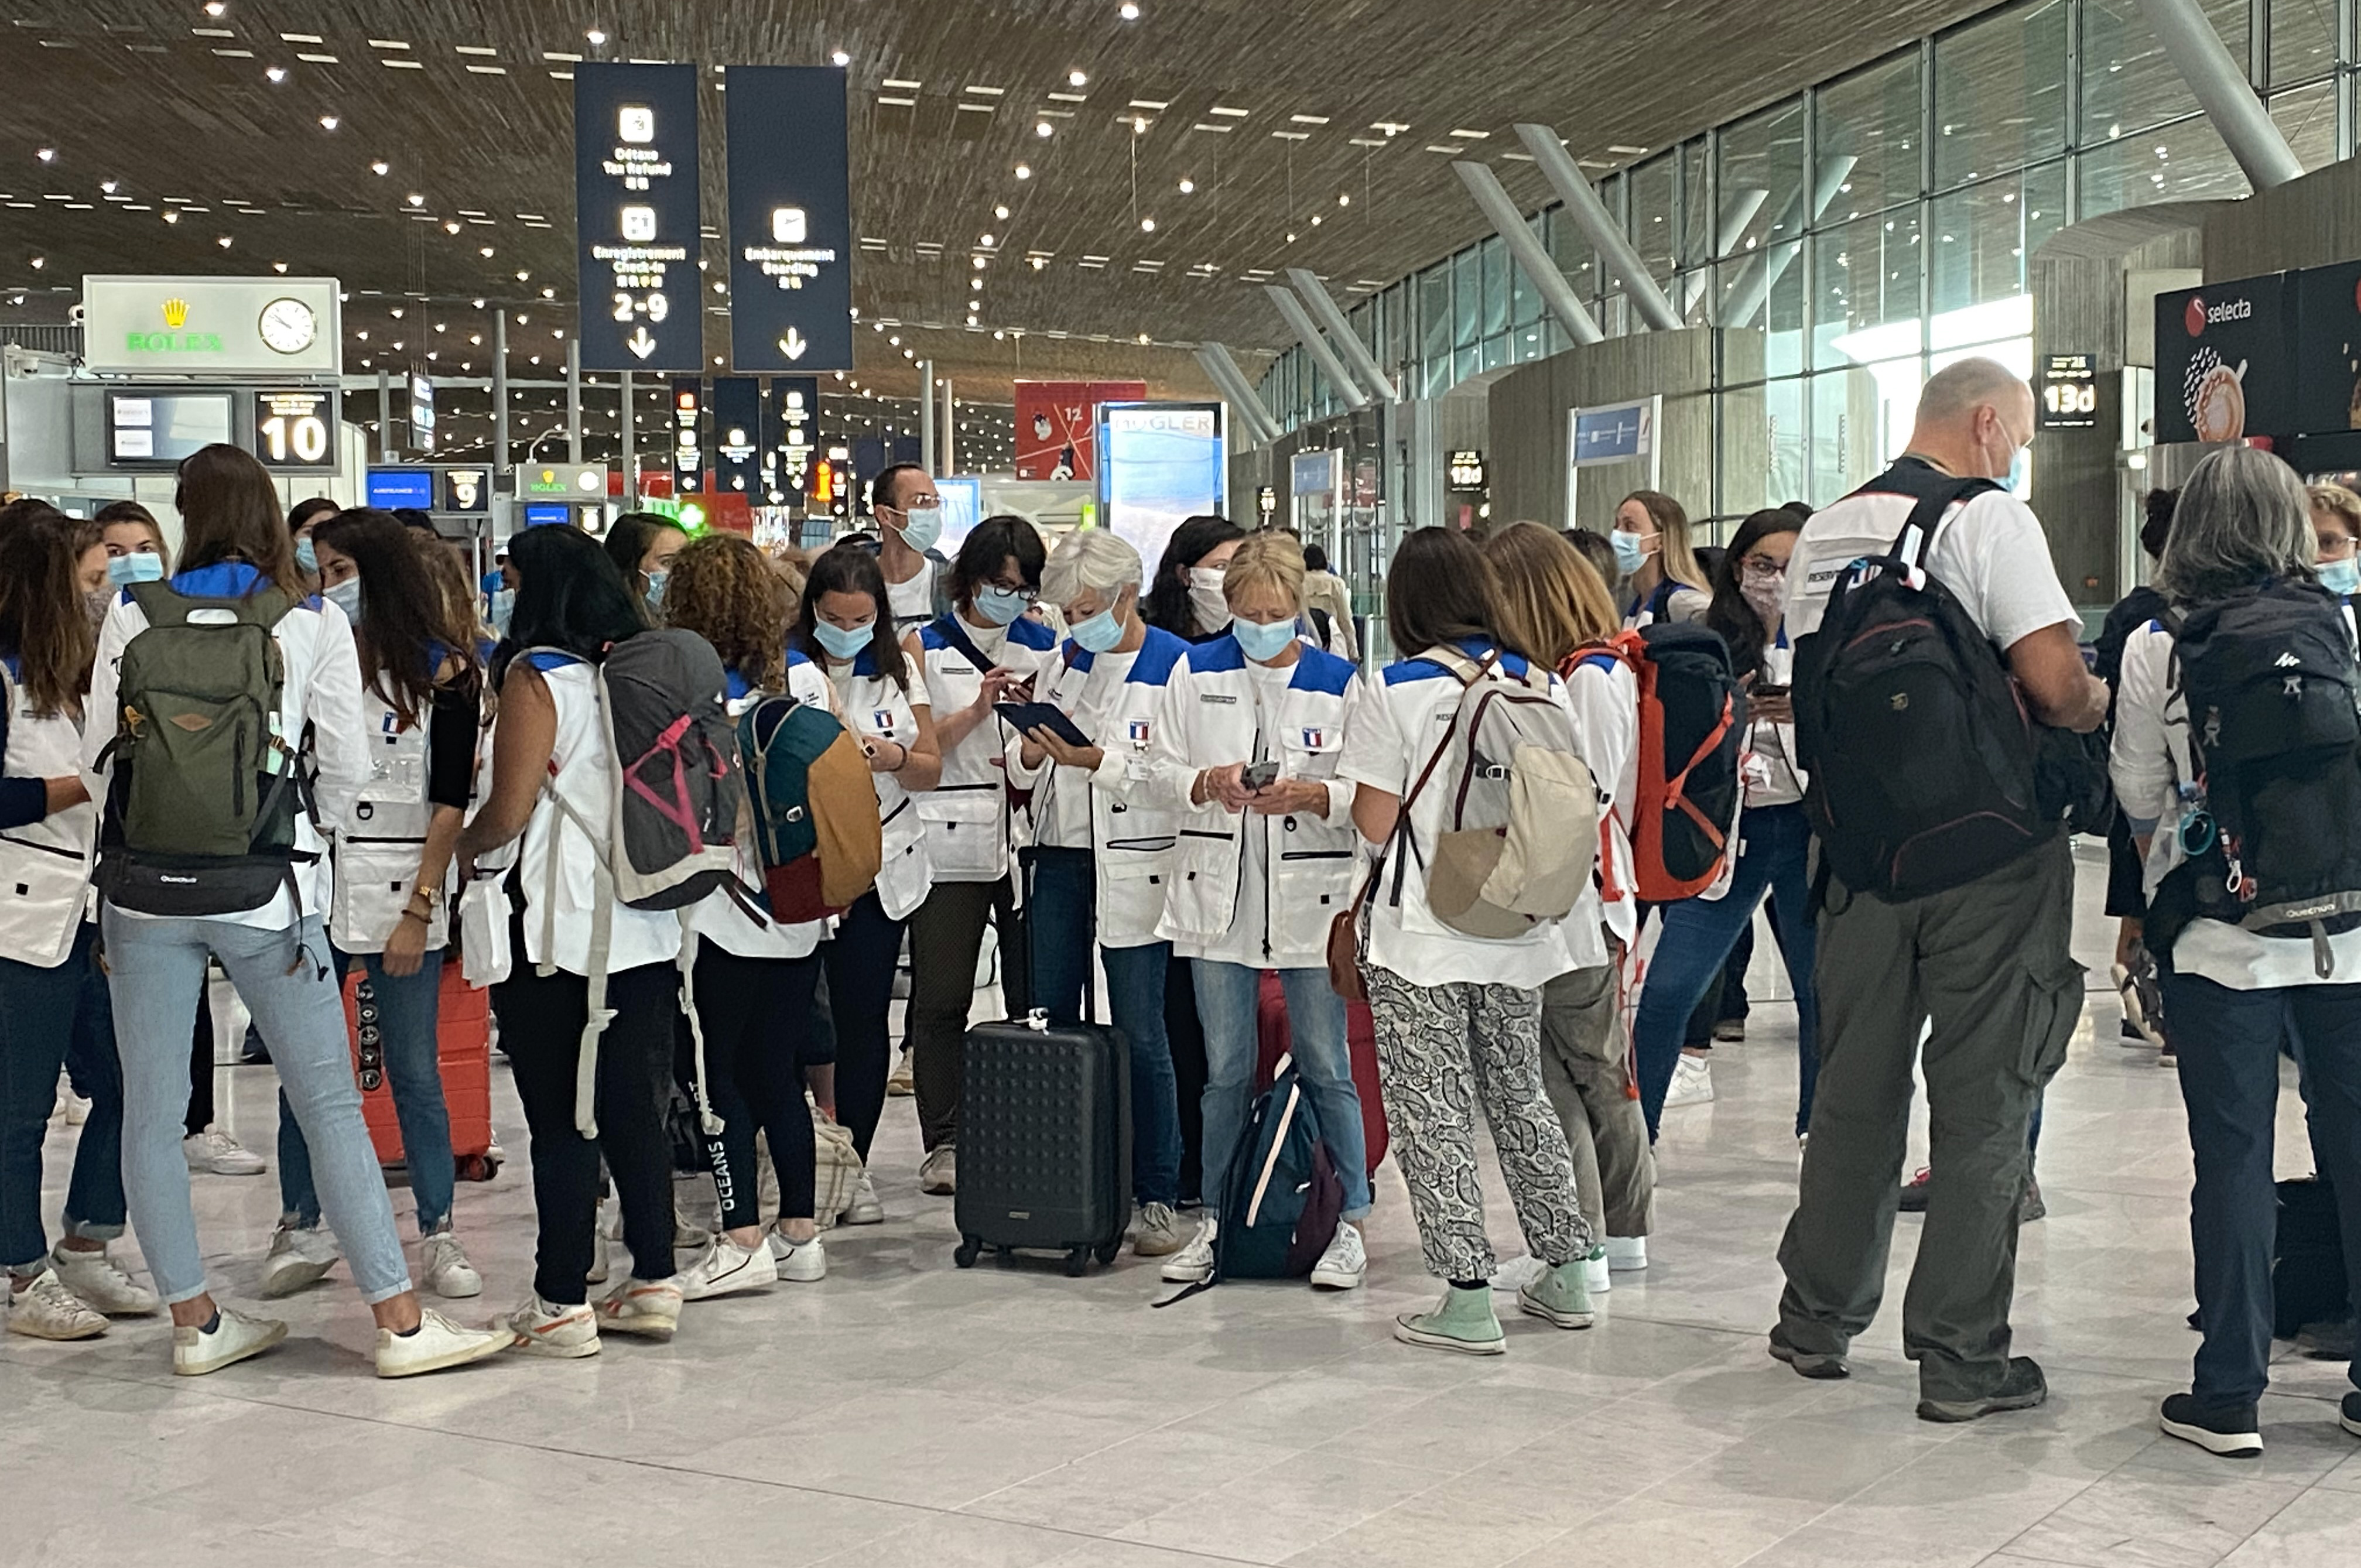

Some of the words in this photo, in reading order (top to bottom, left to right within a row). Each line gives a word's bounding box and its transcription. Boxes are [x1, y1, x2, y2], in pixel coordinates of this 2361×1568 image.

[592, 245, 686, 261] Enregistrement
[744, 247, 836, 263] Embarquement
[762, 261, 819, 278] Boarding
[614, 293, 668, 322] 2-9
[2207, 298, 2251, 324] selecta
[126, 332, 223, 352] ROLEX
[2044, 384, 2096, 414] 13d
[1064, 407, 1083, 422] 12
[261, 416, 327, 461] 10
[1450, 465, 1483, 485] 12d
[456, 483, 477, 509] 9
[707, 1141, 735, 1211] OCEANS
